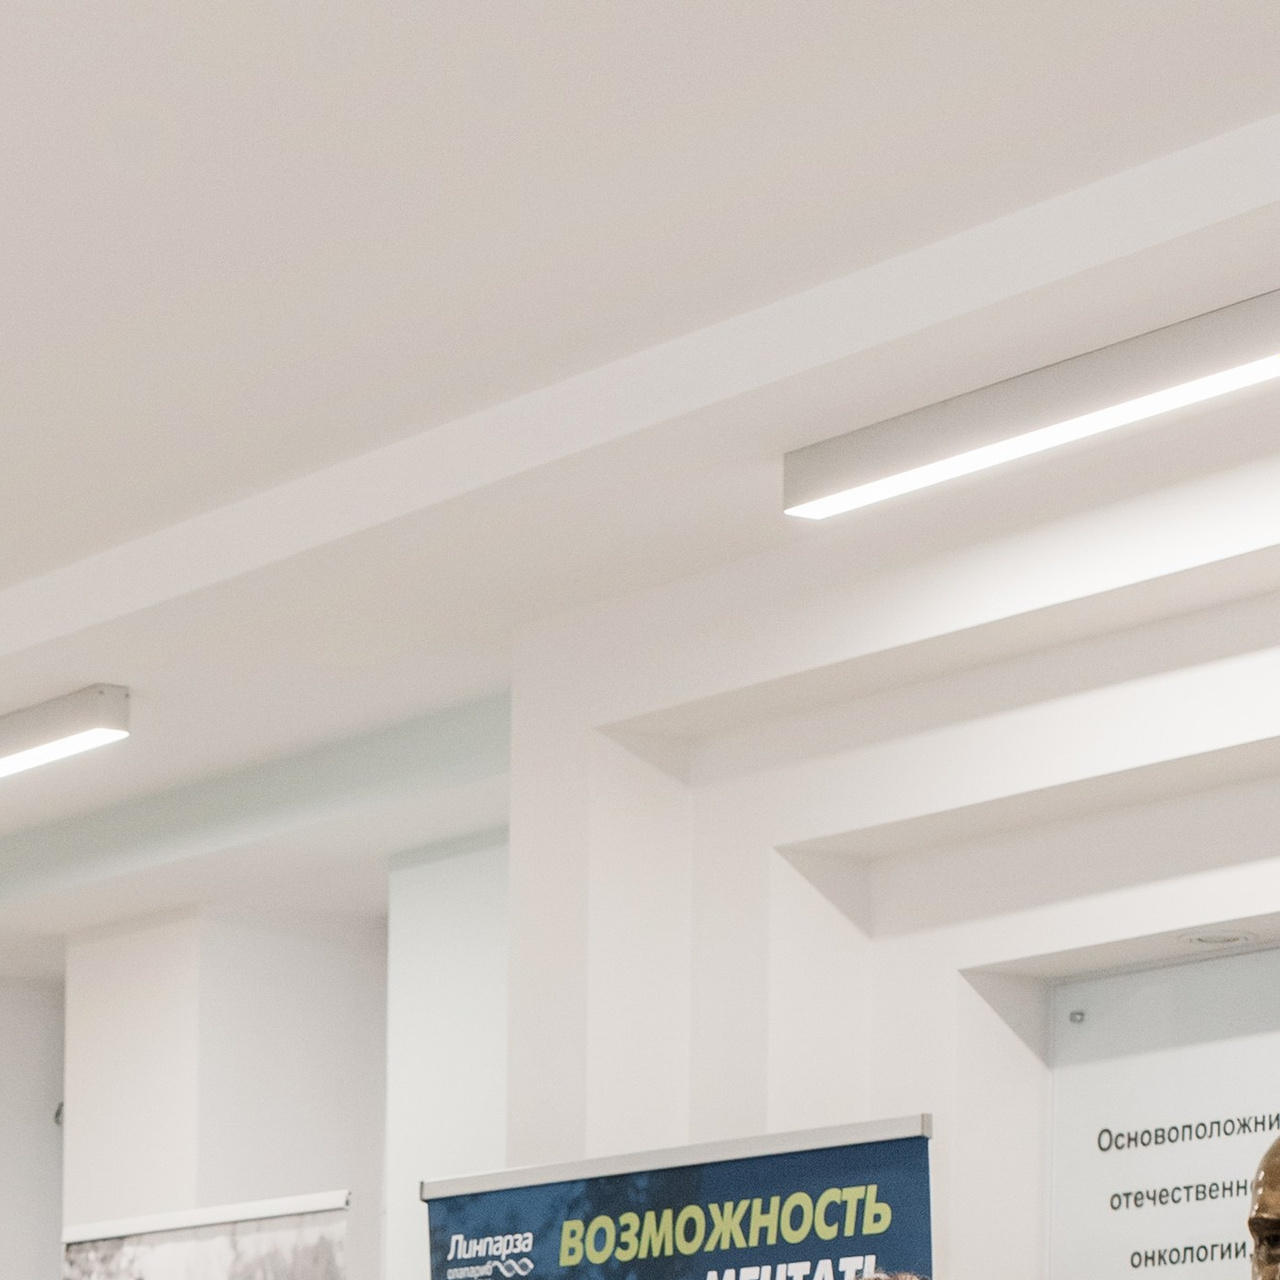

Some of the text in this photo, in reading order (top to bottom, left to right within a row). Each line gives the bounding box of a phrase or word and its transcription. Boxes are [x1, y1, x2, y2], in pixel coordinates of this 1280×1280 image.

[1097, 1113, 1280, 1152] Основоположни
[1110, 1179, 1255, 1211] отечественн
[559, 1184, 892, 1267] ВОЗМОЖНОСТЬ
[447, 1231, 534, 1261] Линпарза
